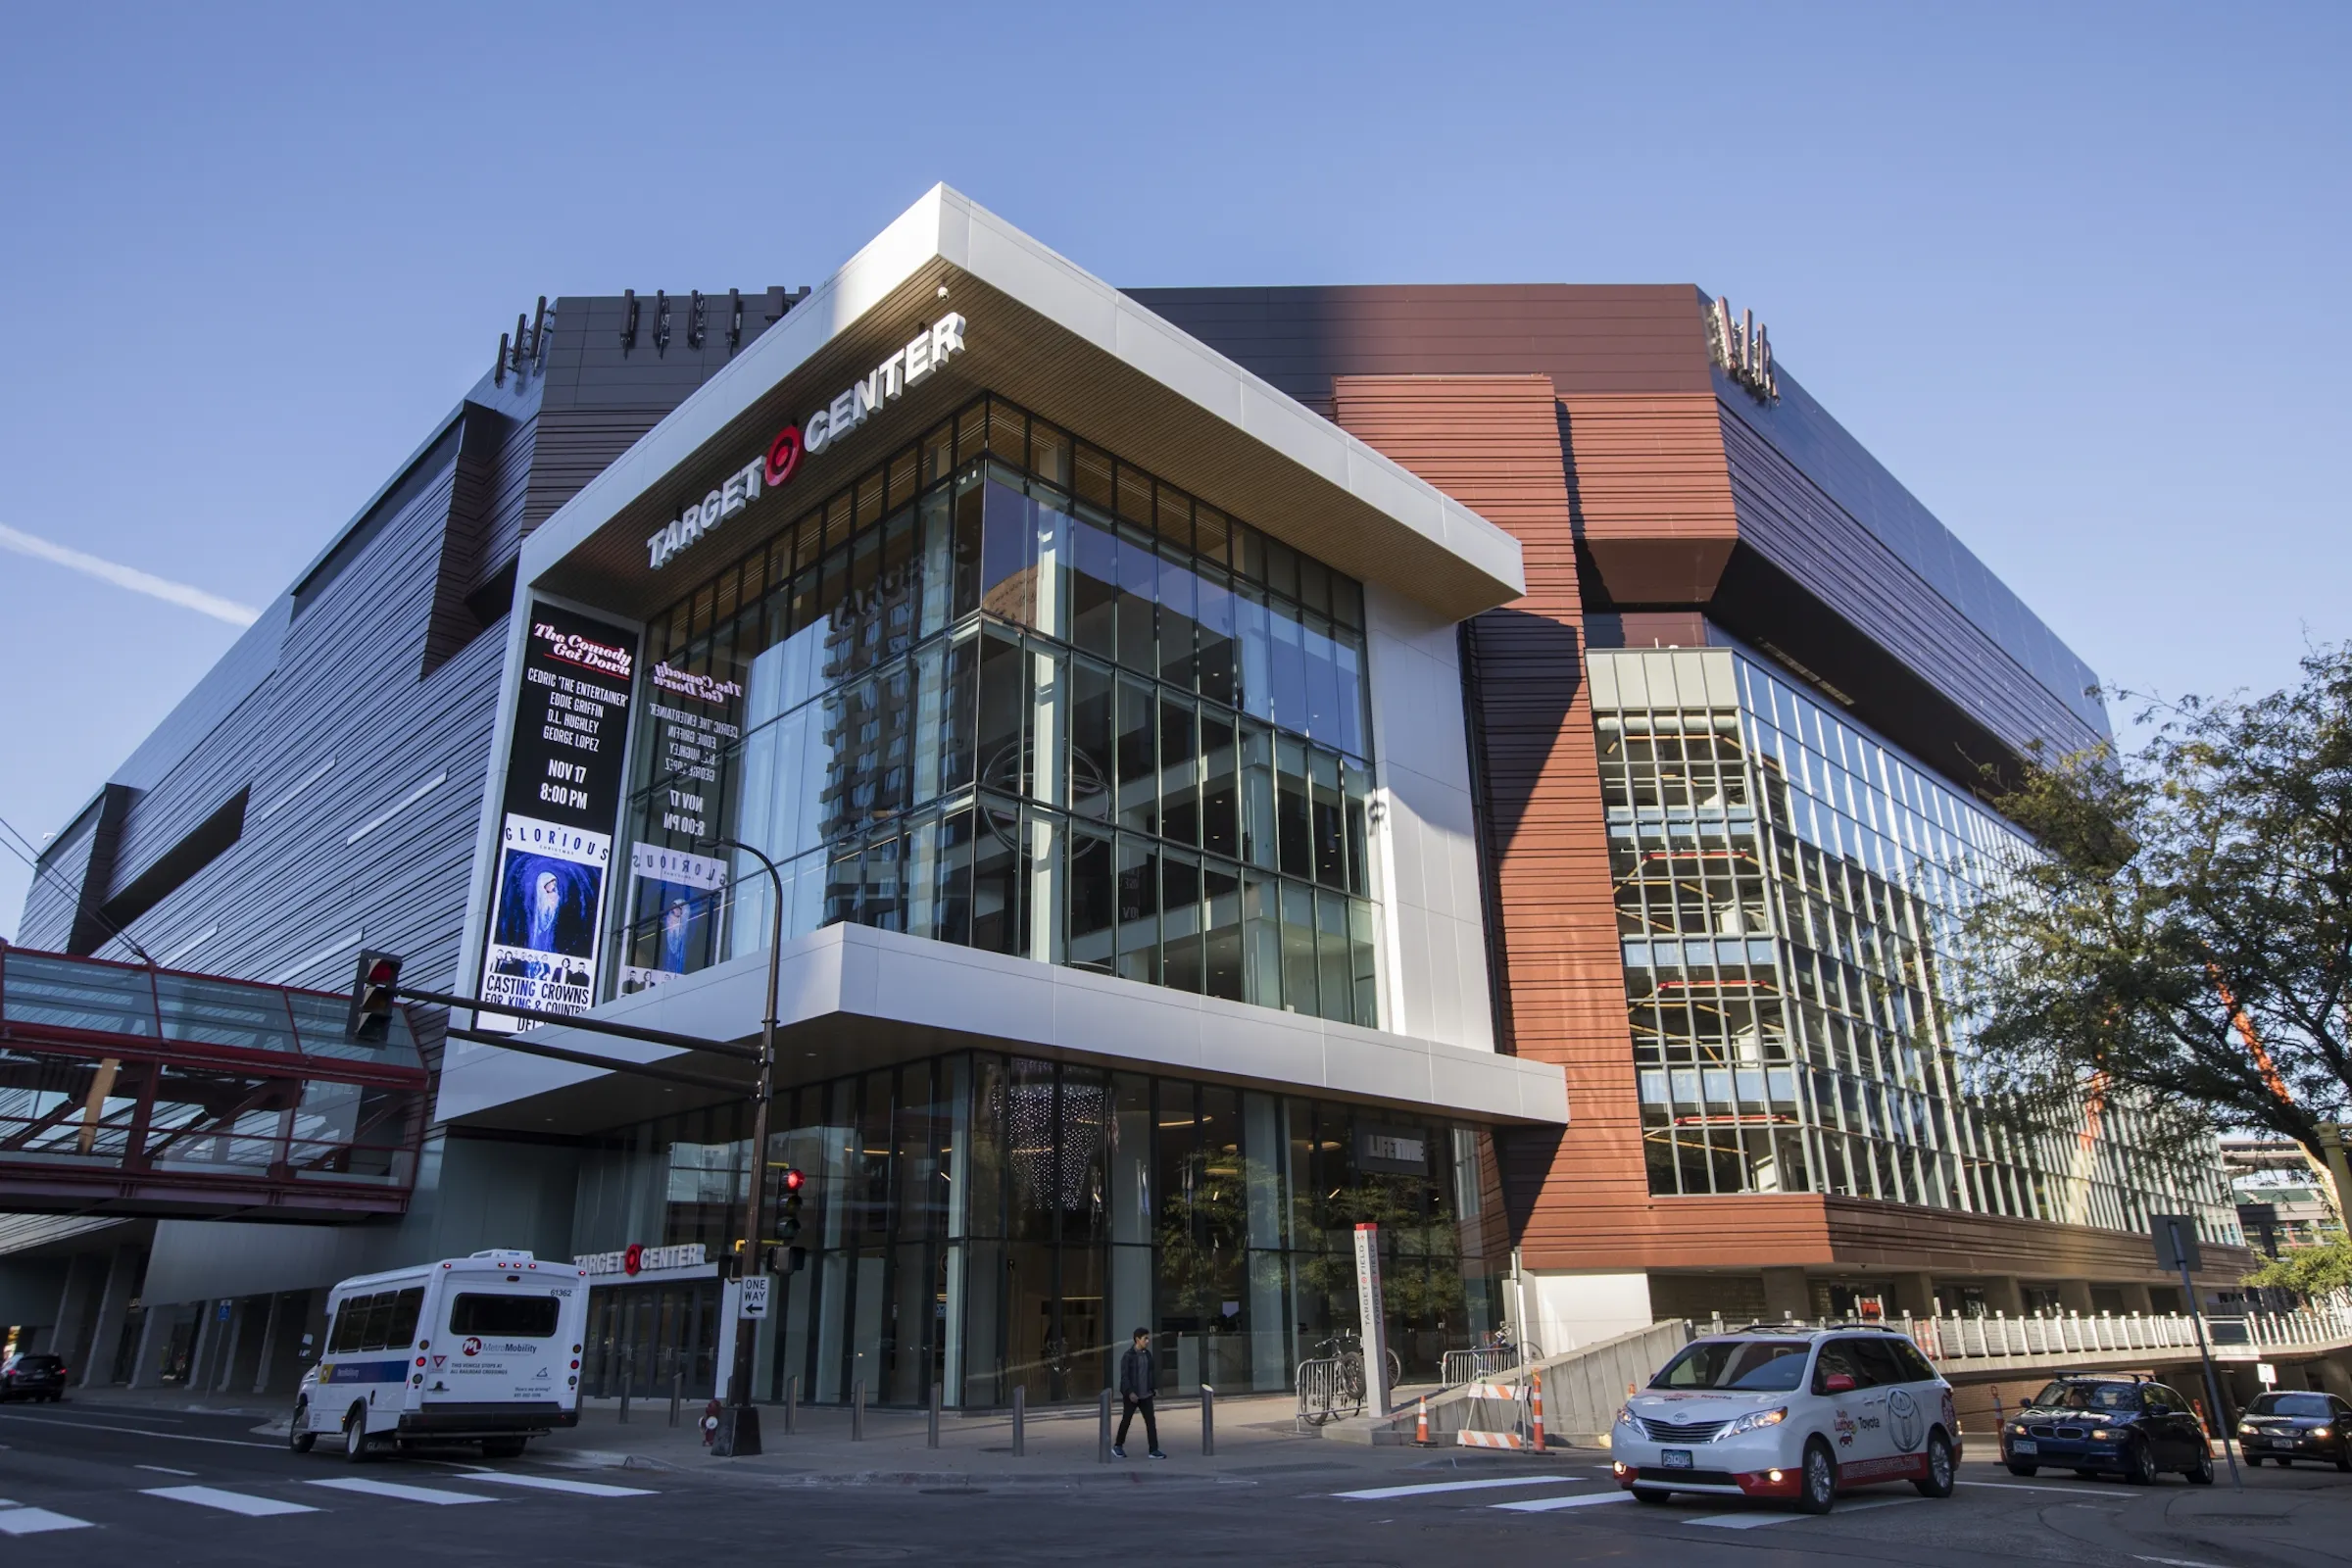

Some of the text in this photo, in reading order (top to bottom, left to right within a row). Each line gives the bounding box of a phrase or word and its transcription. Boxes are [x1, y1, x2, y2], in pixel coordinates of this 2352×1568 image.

[647, 312, 967, 571] TARGET CENTER
[534, 623, 632, 667] The Comedy
[553, 643, 583, 662] Get
[583, 652, 631, 676] Down
[527, 667, 557, 687] CEDRIC
[576, 681, 629, 708] ENTERTAINER'
[550, 692, 605, 718] EDDIE GRIFFIN
[547, 709, 600, 734] D.L. HUGHLEY
[543, 726, 600, 752] GEORGE LOPEZ
[548, 759, 587, 784] NOV 17
[540, 782, 588, 809] 8:00 PM
[505, 827, 609, 860] GLORIOUS
[486, 975, 590, 1004] CASTING CROWNS
[535, 1000, 542, 1010] &
[573, 1243, 705, 1274] TARGET CENTER
[551, 1289, 572, 1298] 61362
[745, 1292, 765, 1302] WAY
[746, 1279, 766, 1290] ONE
[1362, 1286, 1371, 1326] TARGET
[1858, 1415, 1880, 1432] Toyota
